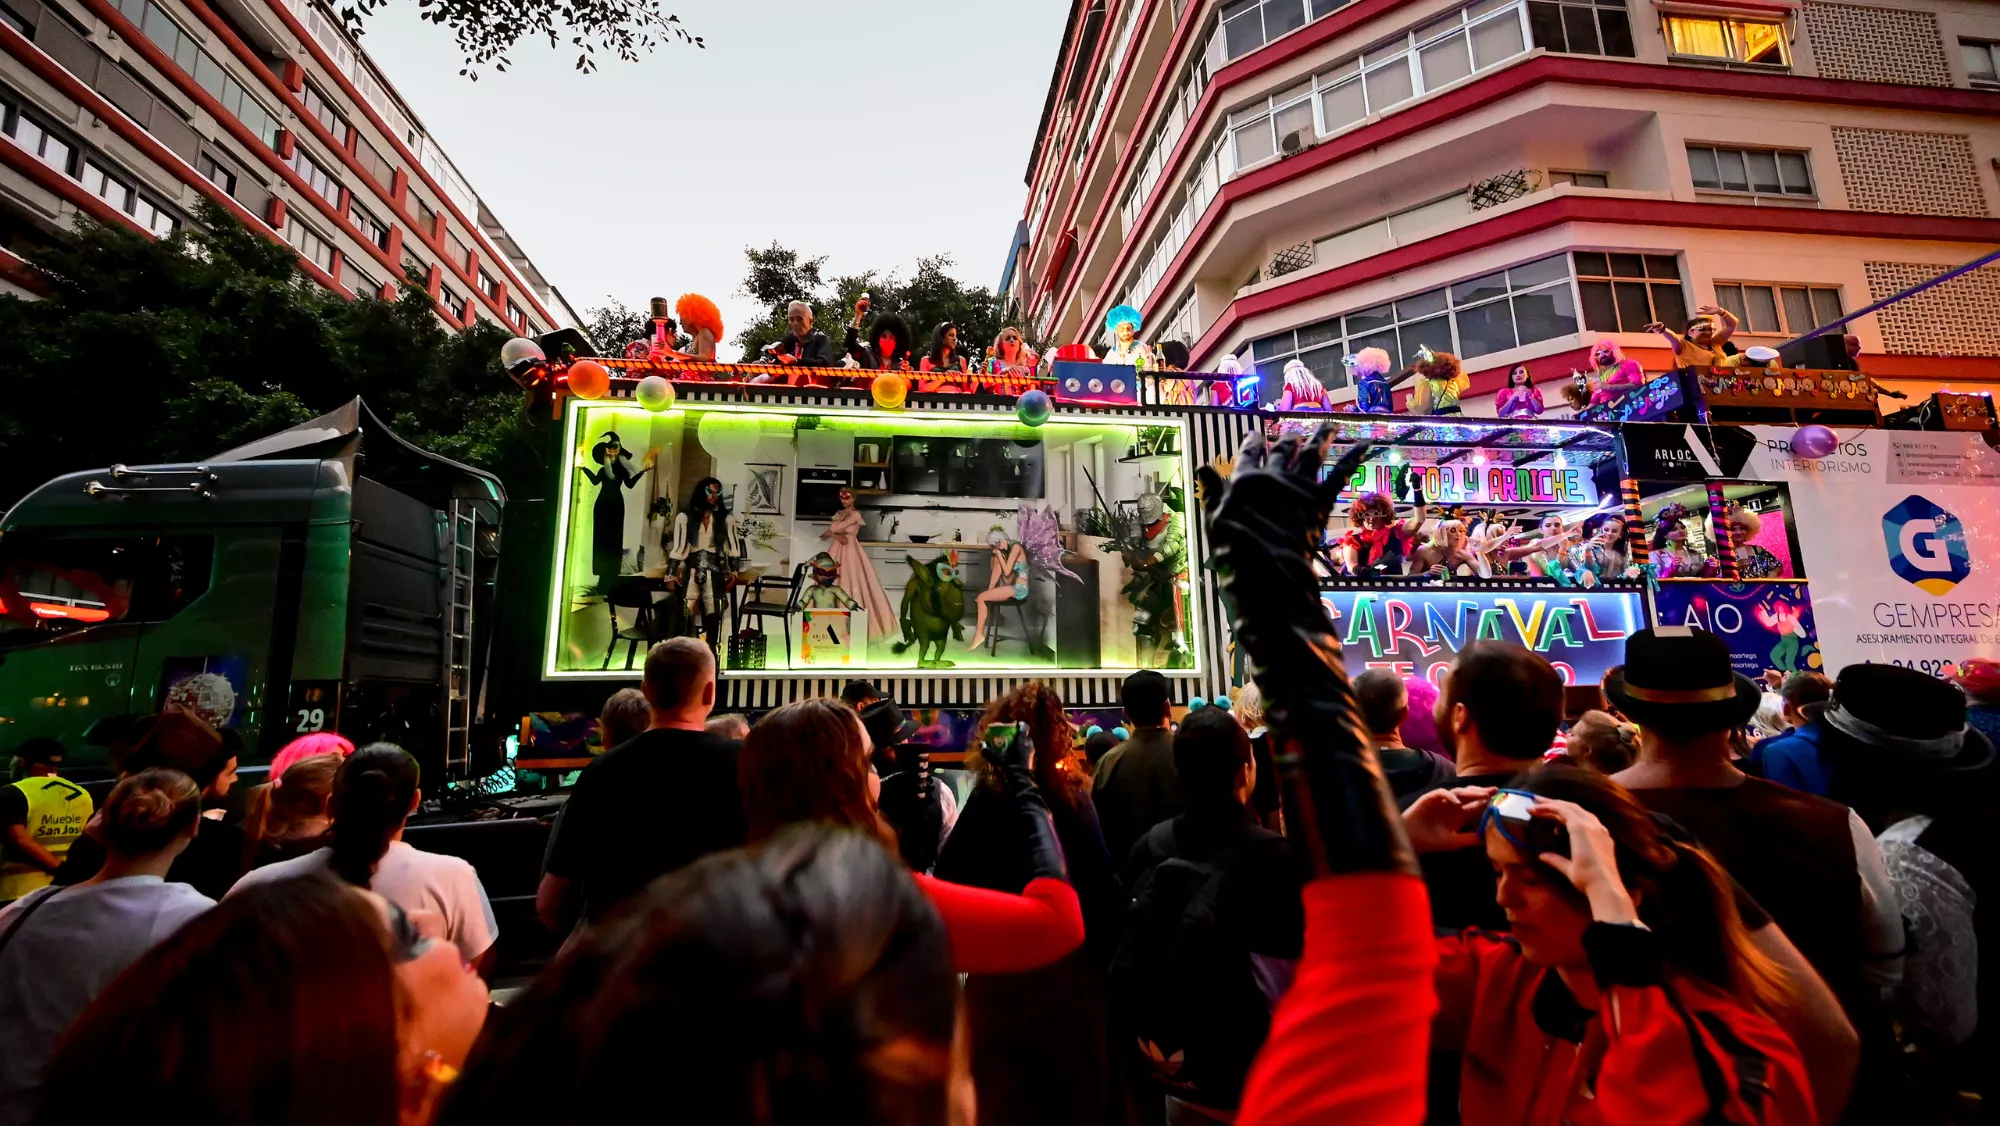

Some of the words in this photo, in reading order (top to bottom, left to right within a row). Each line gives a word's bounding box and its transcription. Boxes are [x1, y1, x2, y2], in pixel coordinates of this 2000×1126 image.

[1655, 449, 1692, 460] ARLOC
[1767, 440, 1867, 456] PRTOS
[1771, 458, 1871, 473] INTERIORISMO
[1376, 466, 1460, 501] VITOR
[1488, 468, 1585, 502] ARMICHE
[1856, 633, 1932, 644] ASESORAMIENTO
[1934, 634, 1979, 644] INTEGRAL
[296, 708, 324, 733] 29
[38, 825, 60, 837] San
